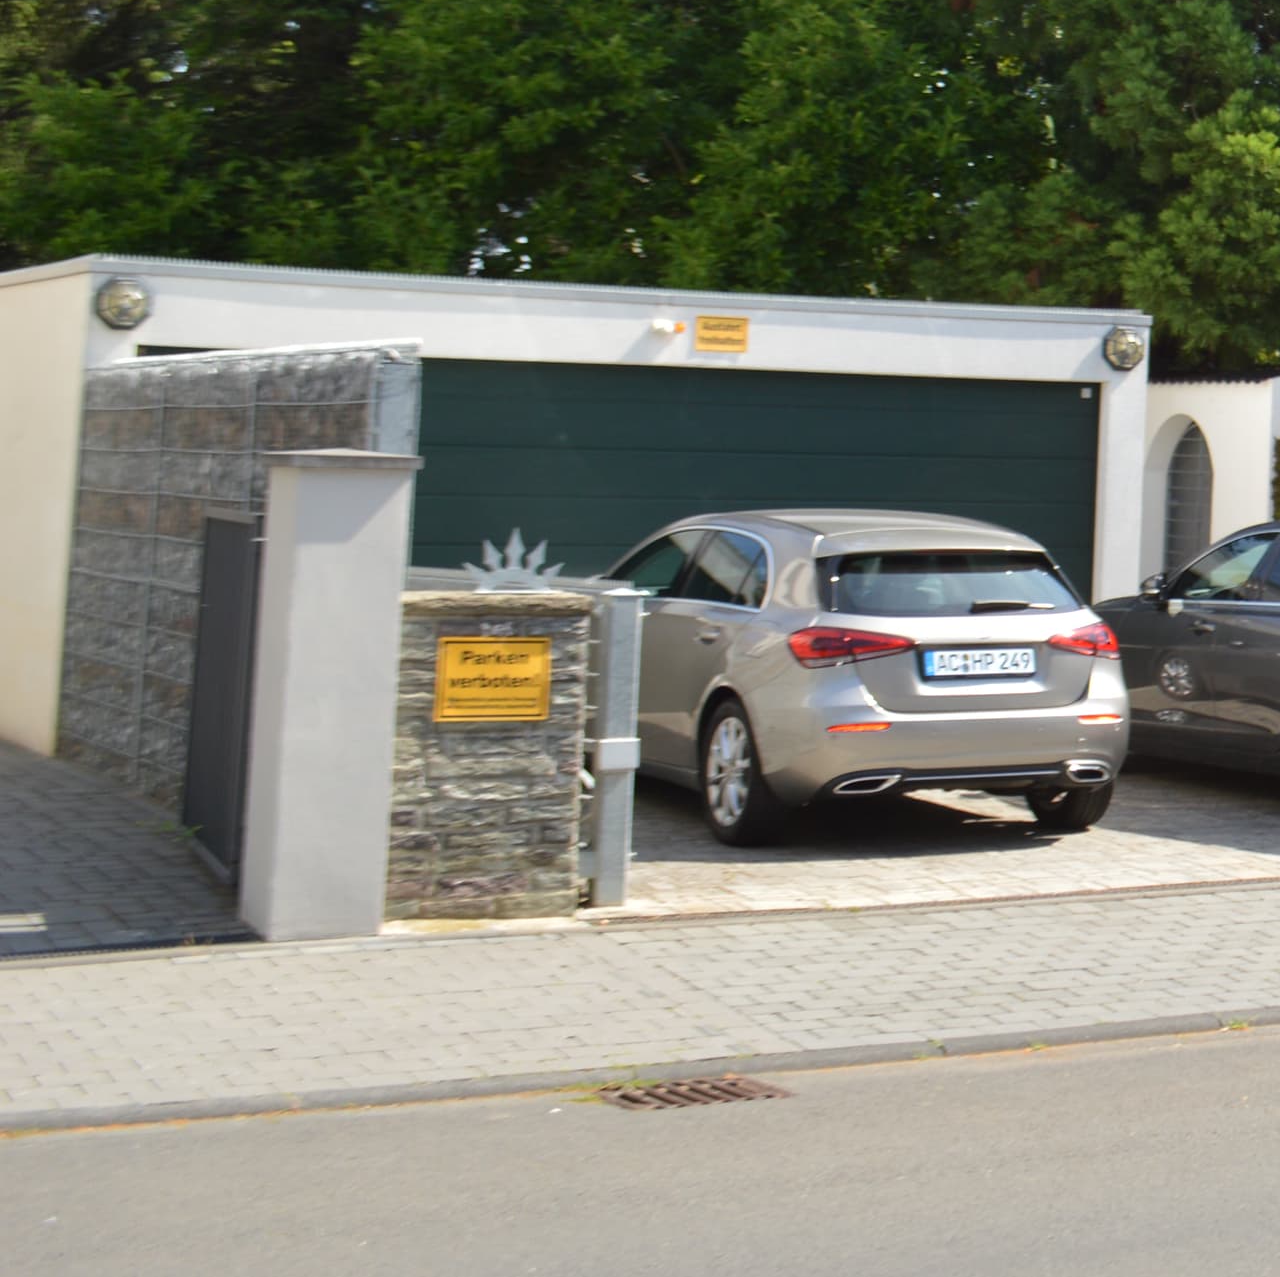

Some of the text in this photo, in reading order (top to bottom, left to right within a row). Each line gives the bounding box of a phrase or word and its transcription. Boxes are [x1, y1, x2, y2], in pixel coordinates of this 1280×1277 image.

[460, 649, 530, 665] Parken
[937, 651, 1031, 673] AC HP 249
